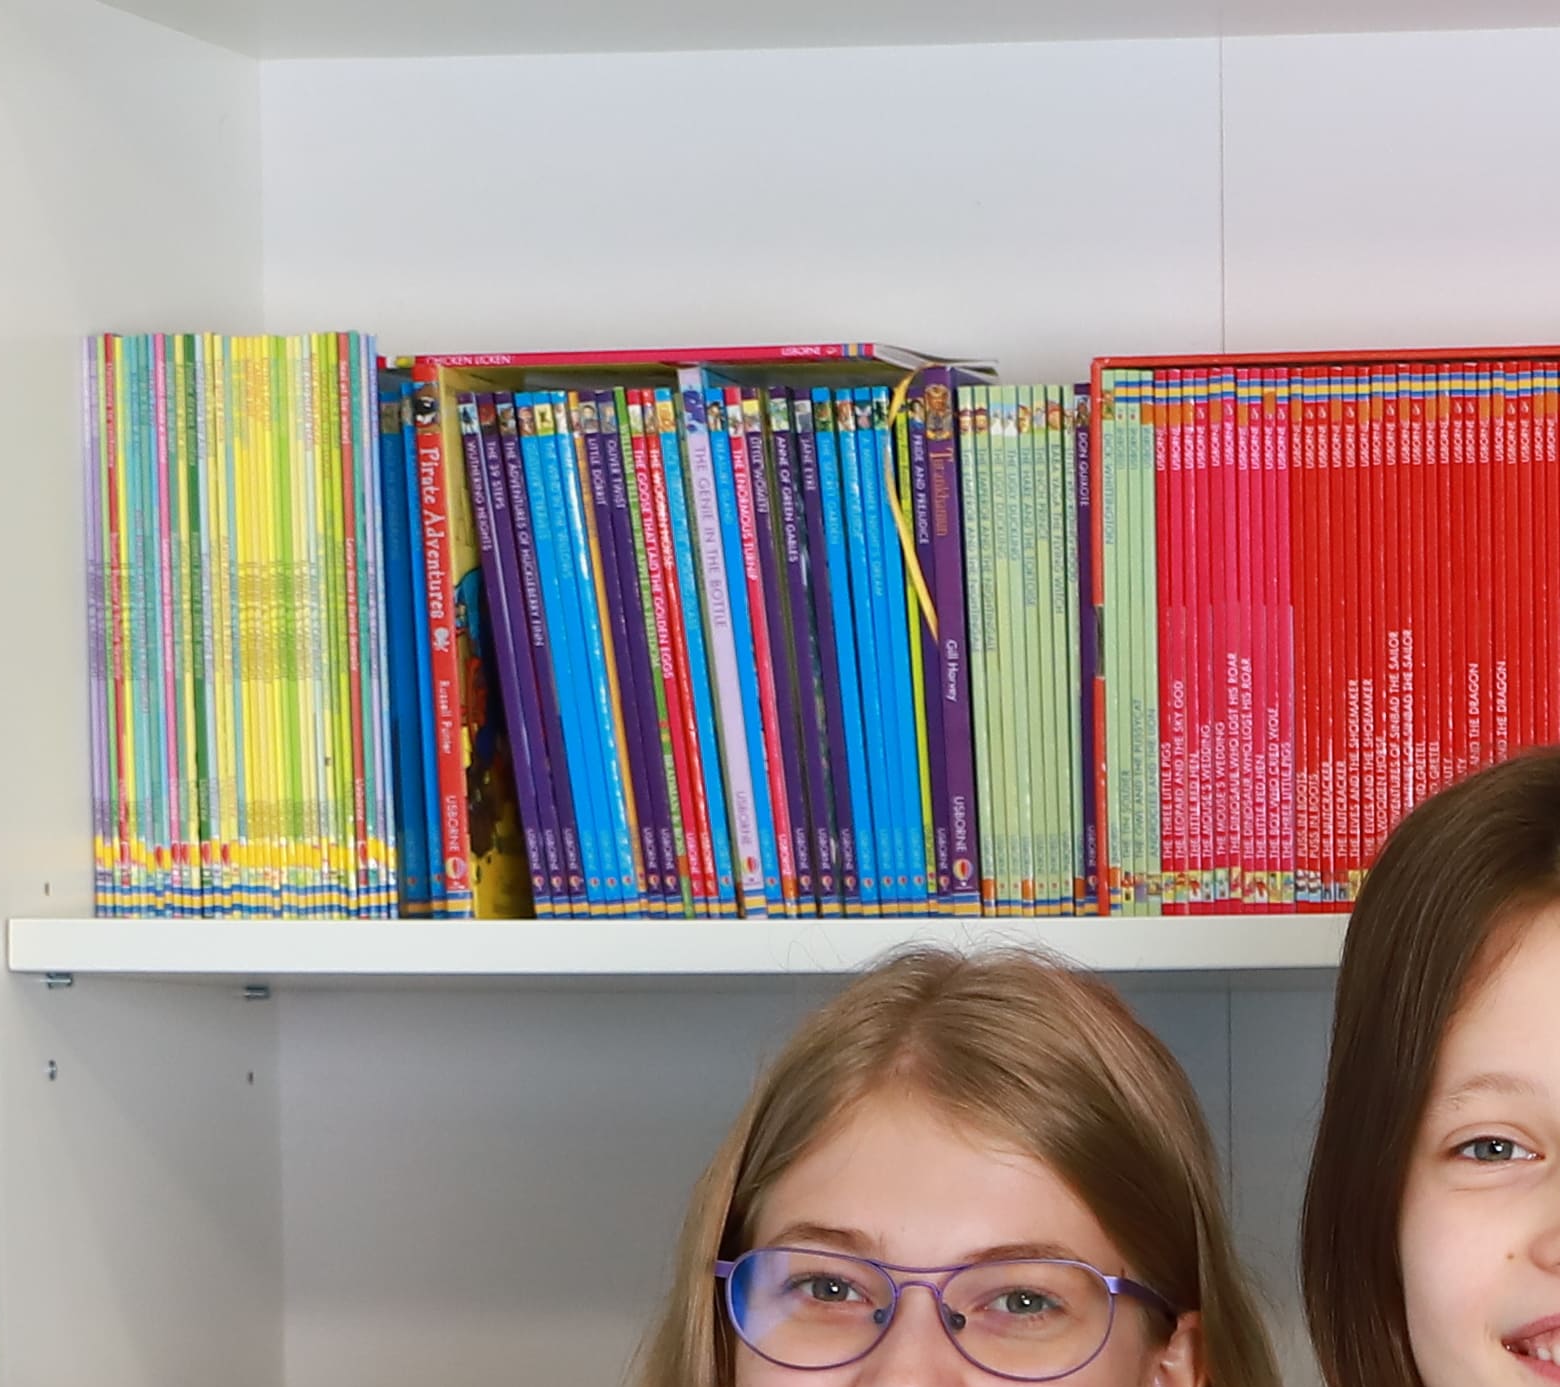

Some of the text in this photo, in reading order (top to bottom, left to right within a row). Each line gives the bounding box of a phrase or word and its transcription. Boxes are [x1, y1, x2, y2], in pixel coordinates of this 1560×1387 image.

[418, 446, 445, 620] Pirate Adventures
[696, 479, 727, 628] GENIE BOTTLE
[944, 640, 960, 702] Gill Harvey
